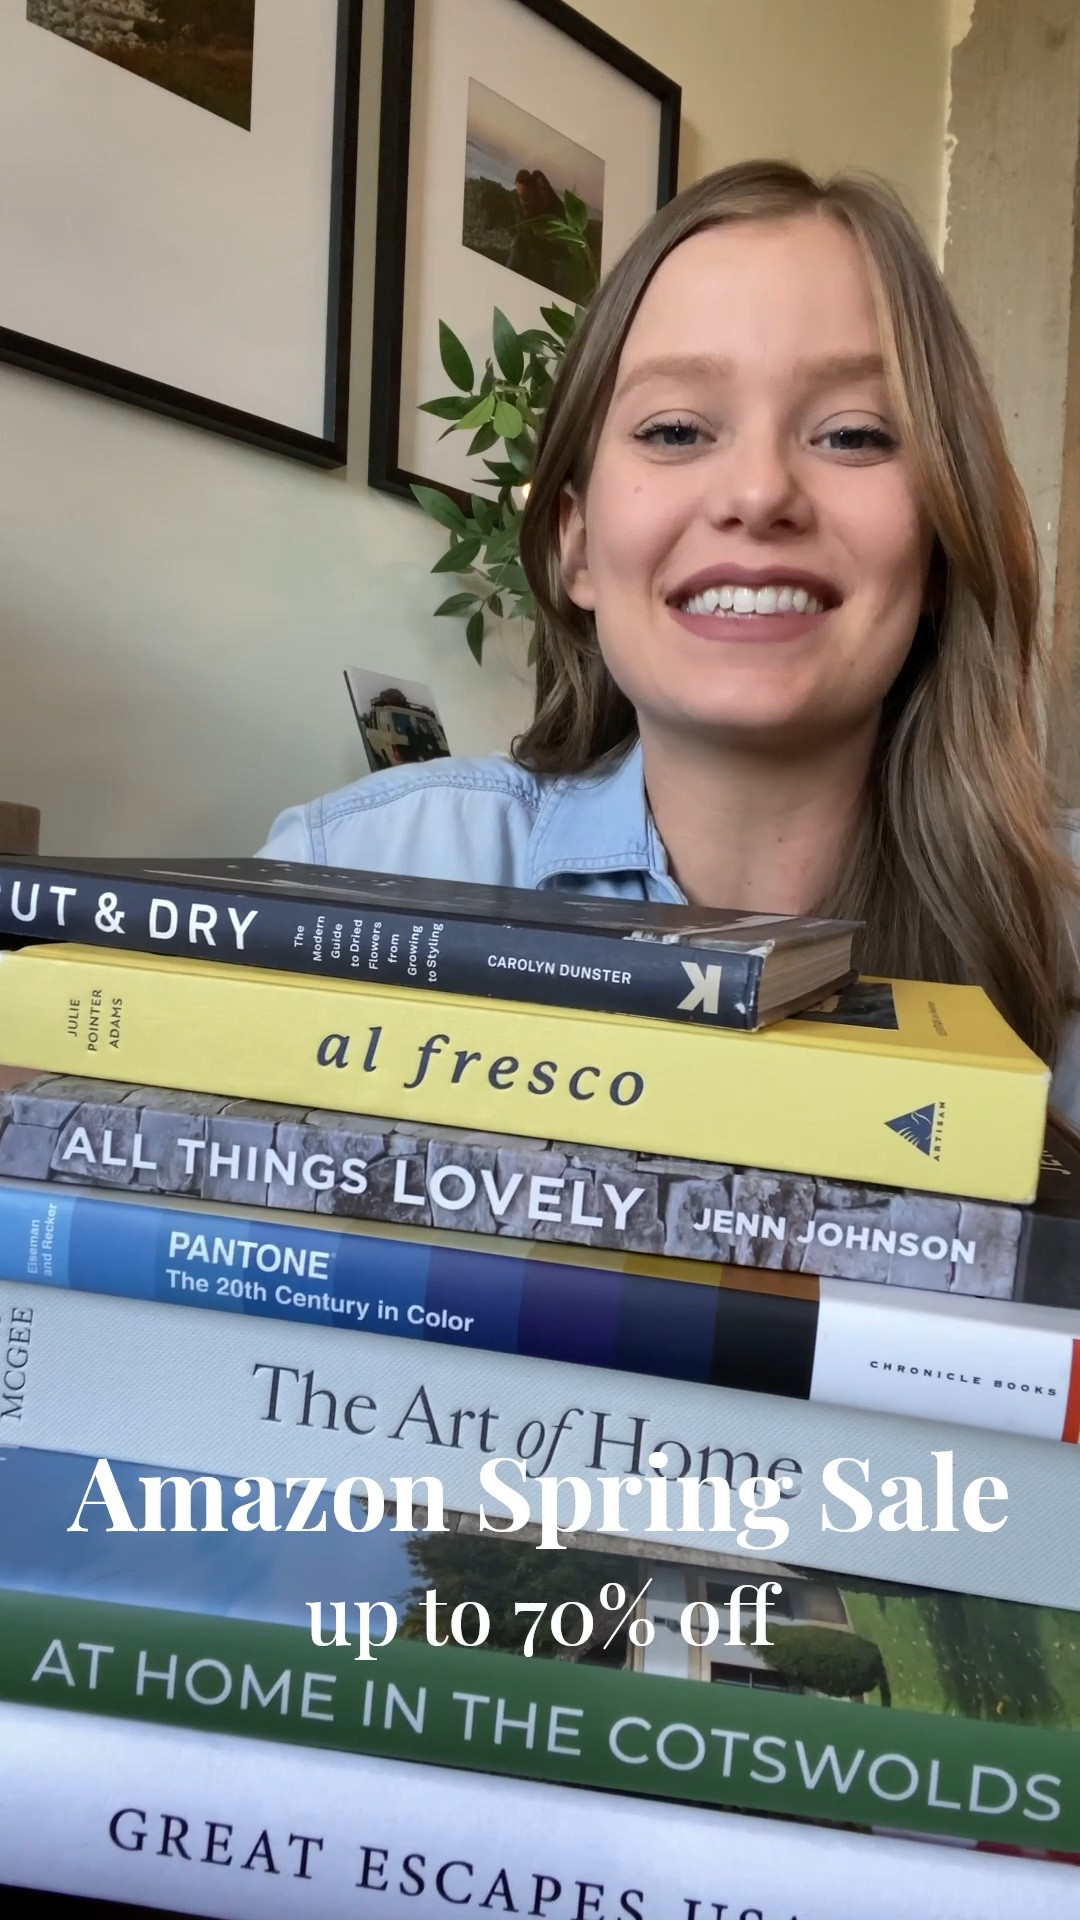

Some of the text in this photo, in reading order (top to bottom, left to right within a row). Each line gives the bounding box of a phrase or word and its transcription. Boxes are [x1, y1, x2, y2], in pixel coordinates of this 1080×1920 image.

[0, 881, 258, 950] UT & DRY
[294, 925, 305, 947] The
[313, 915, 325, 961] Modern
[331, 923, 343, 959] Guide
[350, 919, 363, 967] to Dried
[369, 921, 382, 970] Flowers
[388, 933, 400, 963] from
[408, 925, 423, 976] Growing
[427, 922, 444, 982] to Styling
[488, 955, 632, 985] CAROLYN DUNSTER
[67, 999, 80, 1037] JULIE
[87, 989, 102, 1051] POINTER
[109, 998, 122, 1049] ADAMS
[316, 1026, 645, 1106] al fresco
[933, 1101, 946, 1162] ARTISAN
[62, 1127, 976, 1265] ALL THINGS LOVELY JENN JOHNSON
[27, 1219, 40, 1275] Eiseman
[42, 1202, 57, 1276] and Recker
[168, 1231, 330, 1280] PANTONE
[166, 1269, 474, 1332] The 20th Century in Color
[870, 1360, 1057, 1396] CHRONICLE BOOKS
[252, 1363, 803, 1499] The Art of Home
[31, 1639, 1062, 1822] AT HOME IN THE COTSWOLDS
[109, 1808, 645, 1920] GREAT ESCAPES
